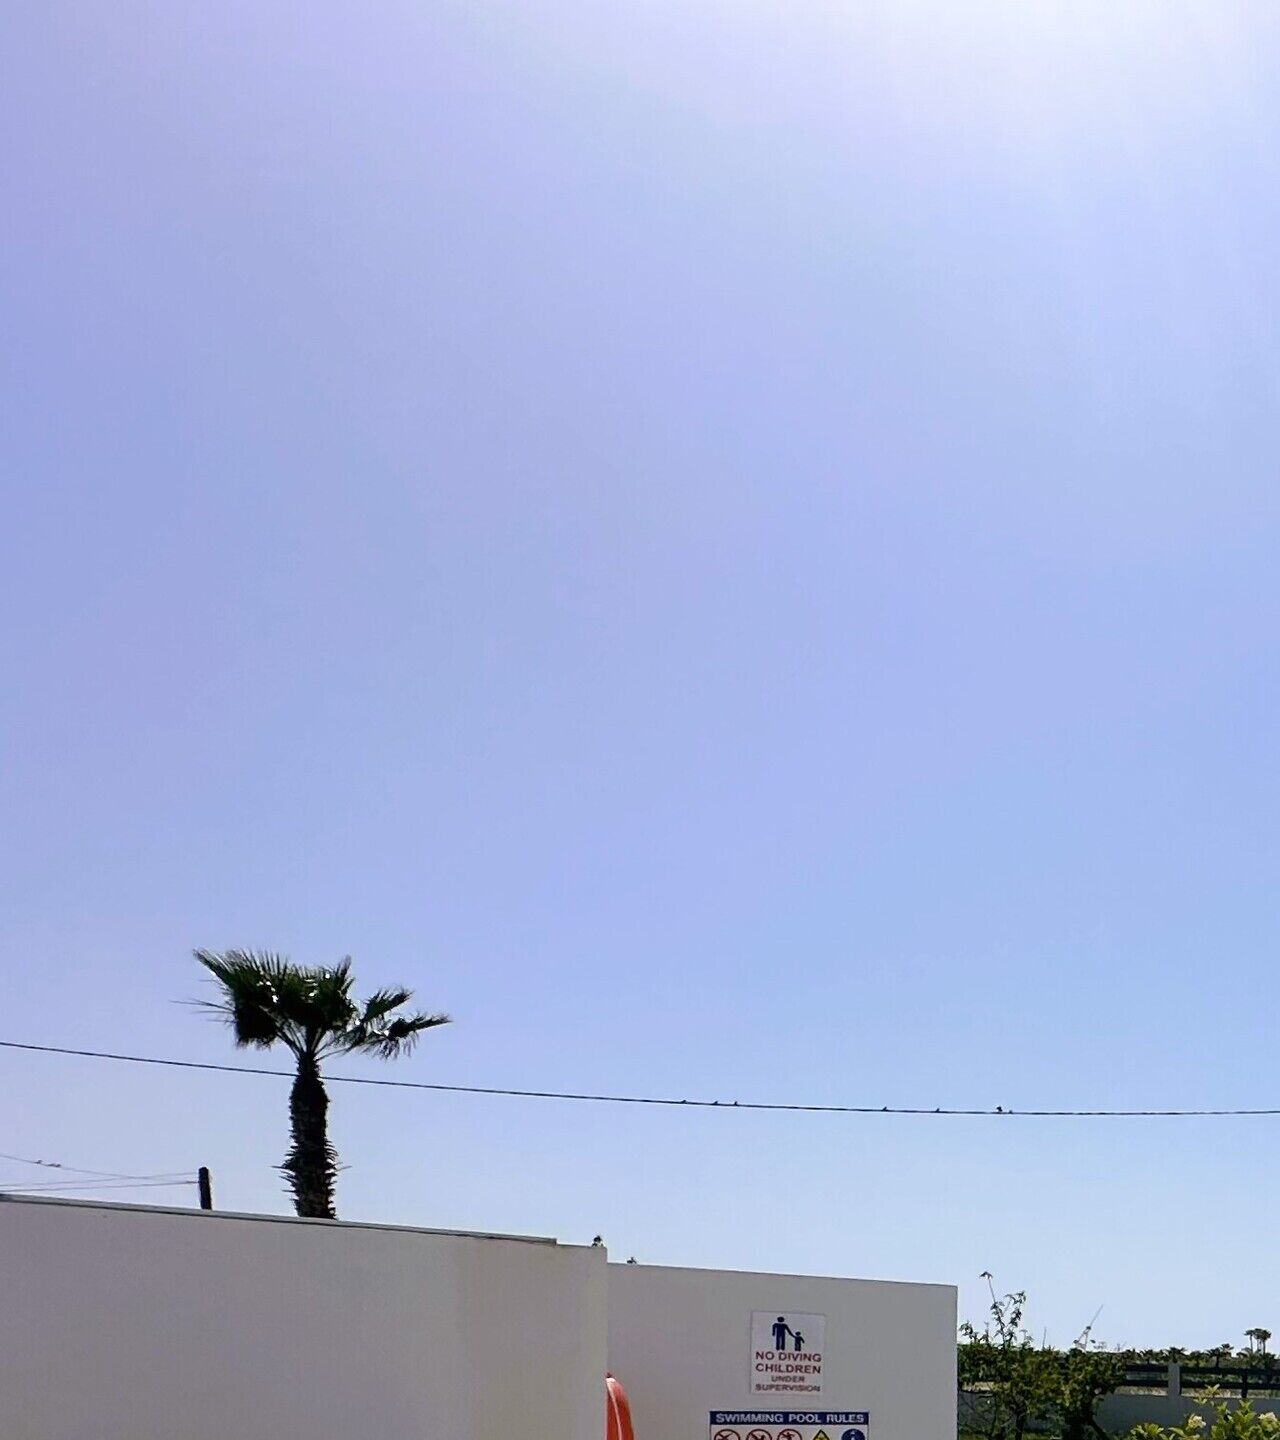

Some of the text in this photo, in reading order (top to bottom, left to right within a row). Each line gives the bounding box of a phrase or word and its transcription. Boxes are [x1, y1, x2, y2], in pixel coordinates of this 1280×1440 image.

[756, 1351, 822, 1362] NO DIVING
[756, 1363, 821, 1373] CHILDREN
[756, 1384, 821, 1392] SUPERVISION
[716, 1413, 864, 1423] SWIMMING POOL RULES
